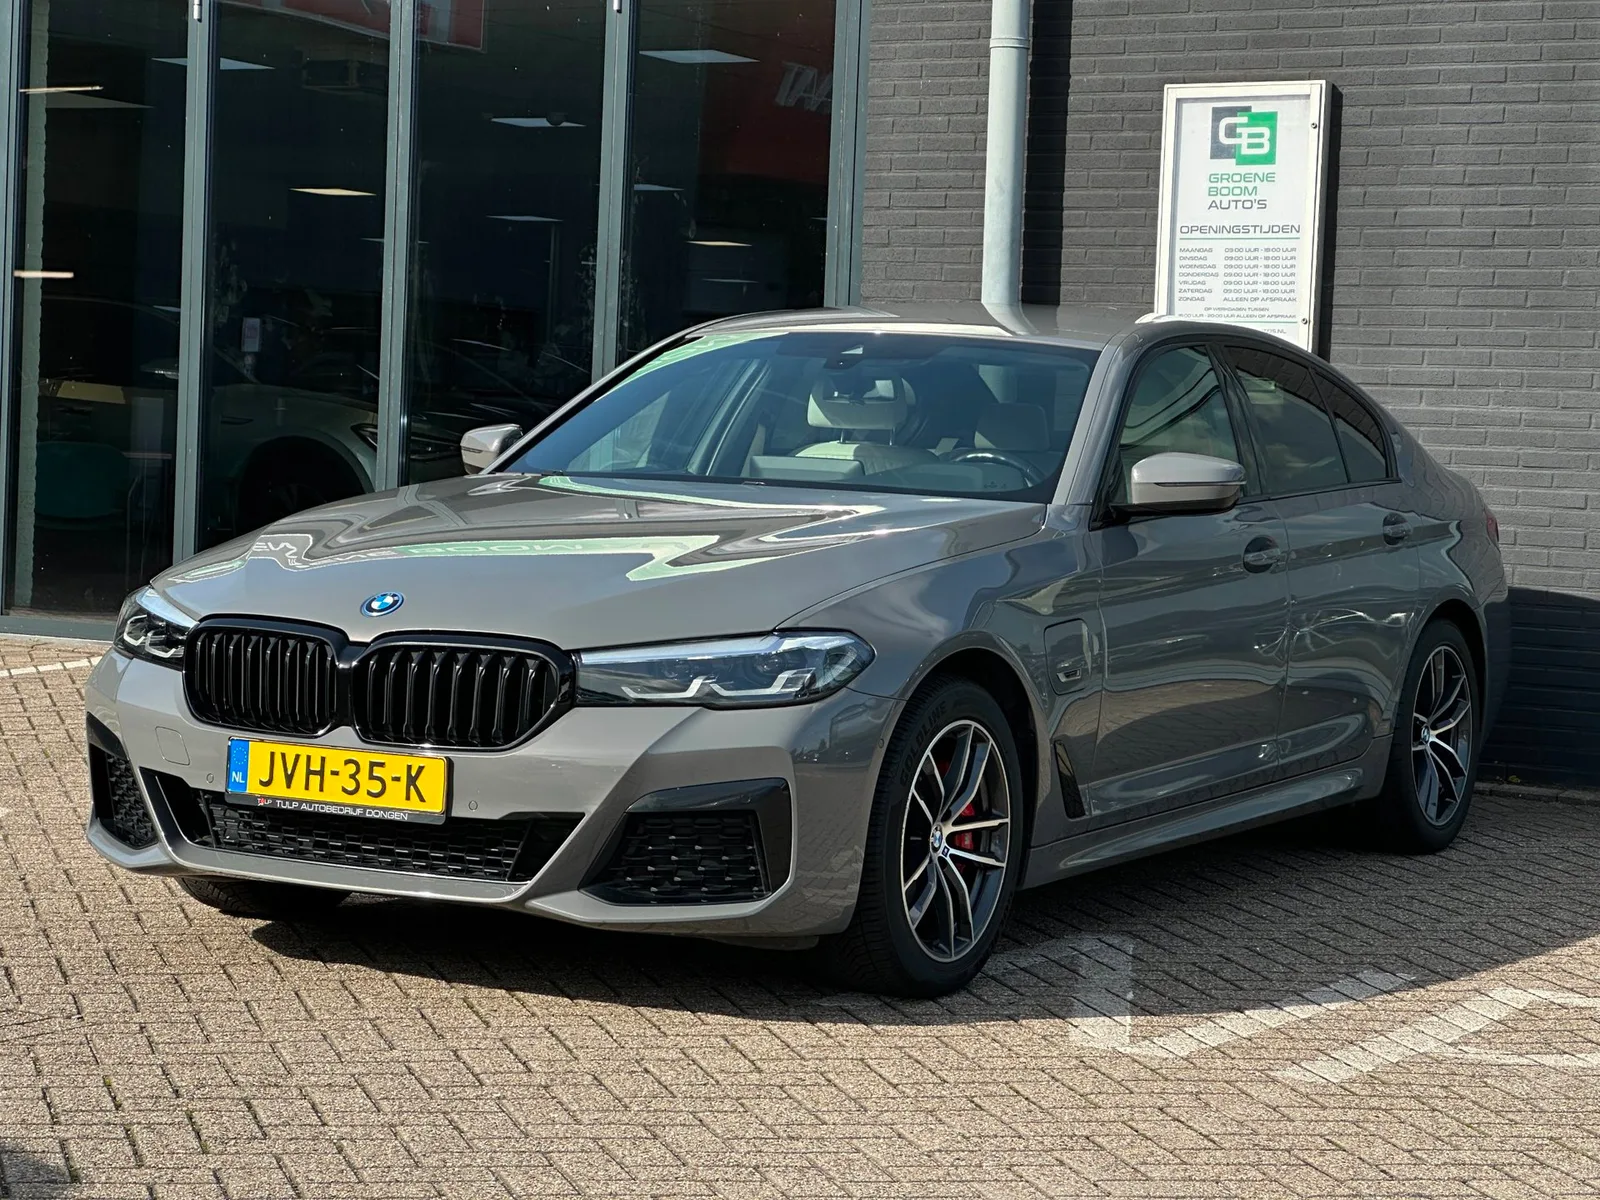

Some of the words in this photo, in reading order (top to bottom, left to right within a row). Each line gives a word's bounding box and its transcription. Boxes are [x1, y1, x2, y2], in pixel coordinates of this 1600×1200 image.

[1208, 172, 1276, 184] GROENE
[1207, 186, 1258, 197] BOOM
[1207, 199, 1268, 210] AUTO'S
[1179, 224, 1301, 234] OPENINGSTIJDEN
[231, 772, 246, 784] NL
[258, 751, 427, 803] JVH-35-K
[275, 799, 299, 809] TULP
[300, 803, 364, 816] AUTOBEDRIJF
[365, 809, 409, 820] DONGEN
